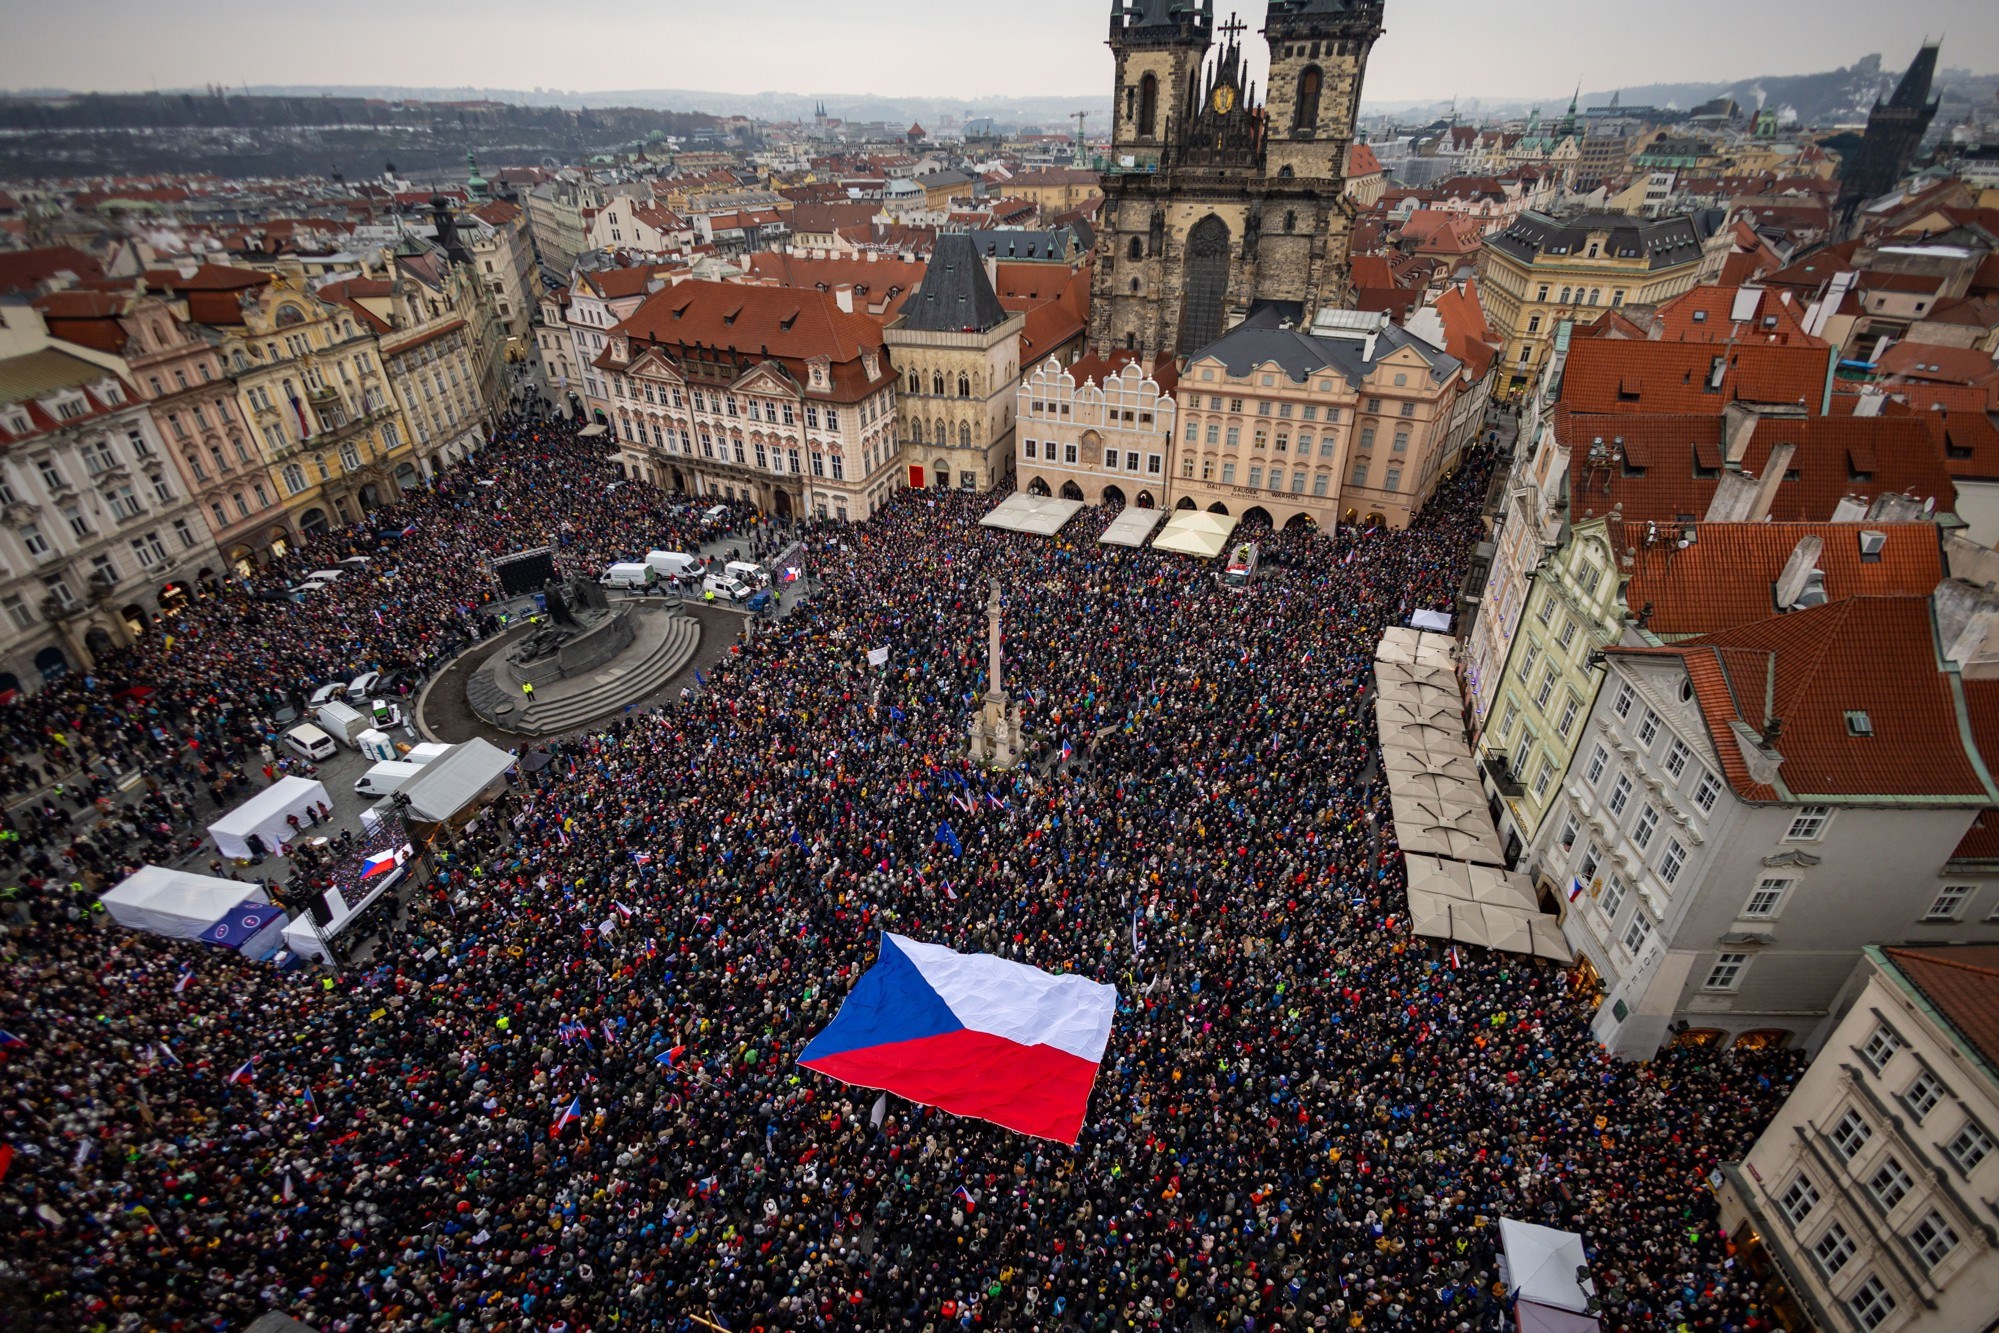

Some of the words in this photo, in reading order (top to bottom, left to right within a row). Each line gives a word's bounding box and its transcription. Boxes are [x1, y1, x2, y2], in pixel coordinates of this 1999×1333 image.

[1206, 483, 1221, 491] DALI
[1232, 486, 1258, 495] SAUDEK
[1271, 492, 1299, 501] WARHOL
[1625, 947, 1657, 994] HOTEL
